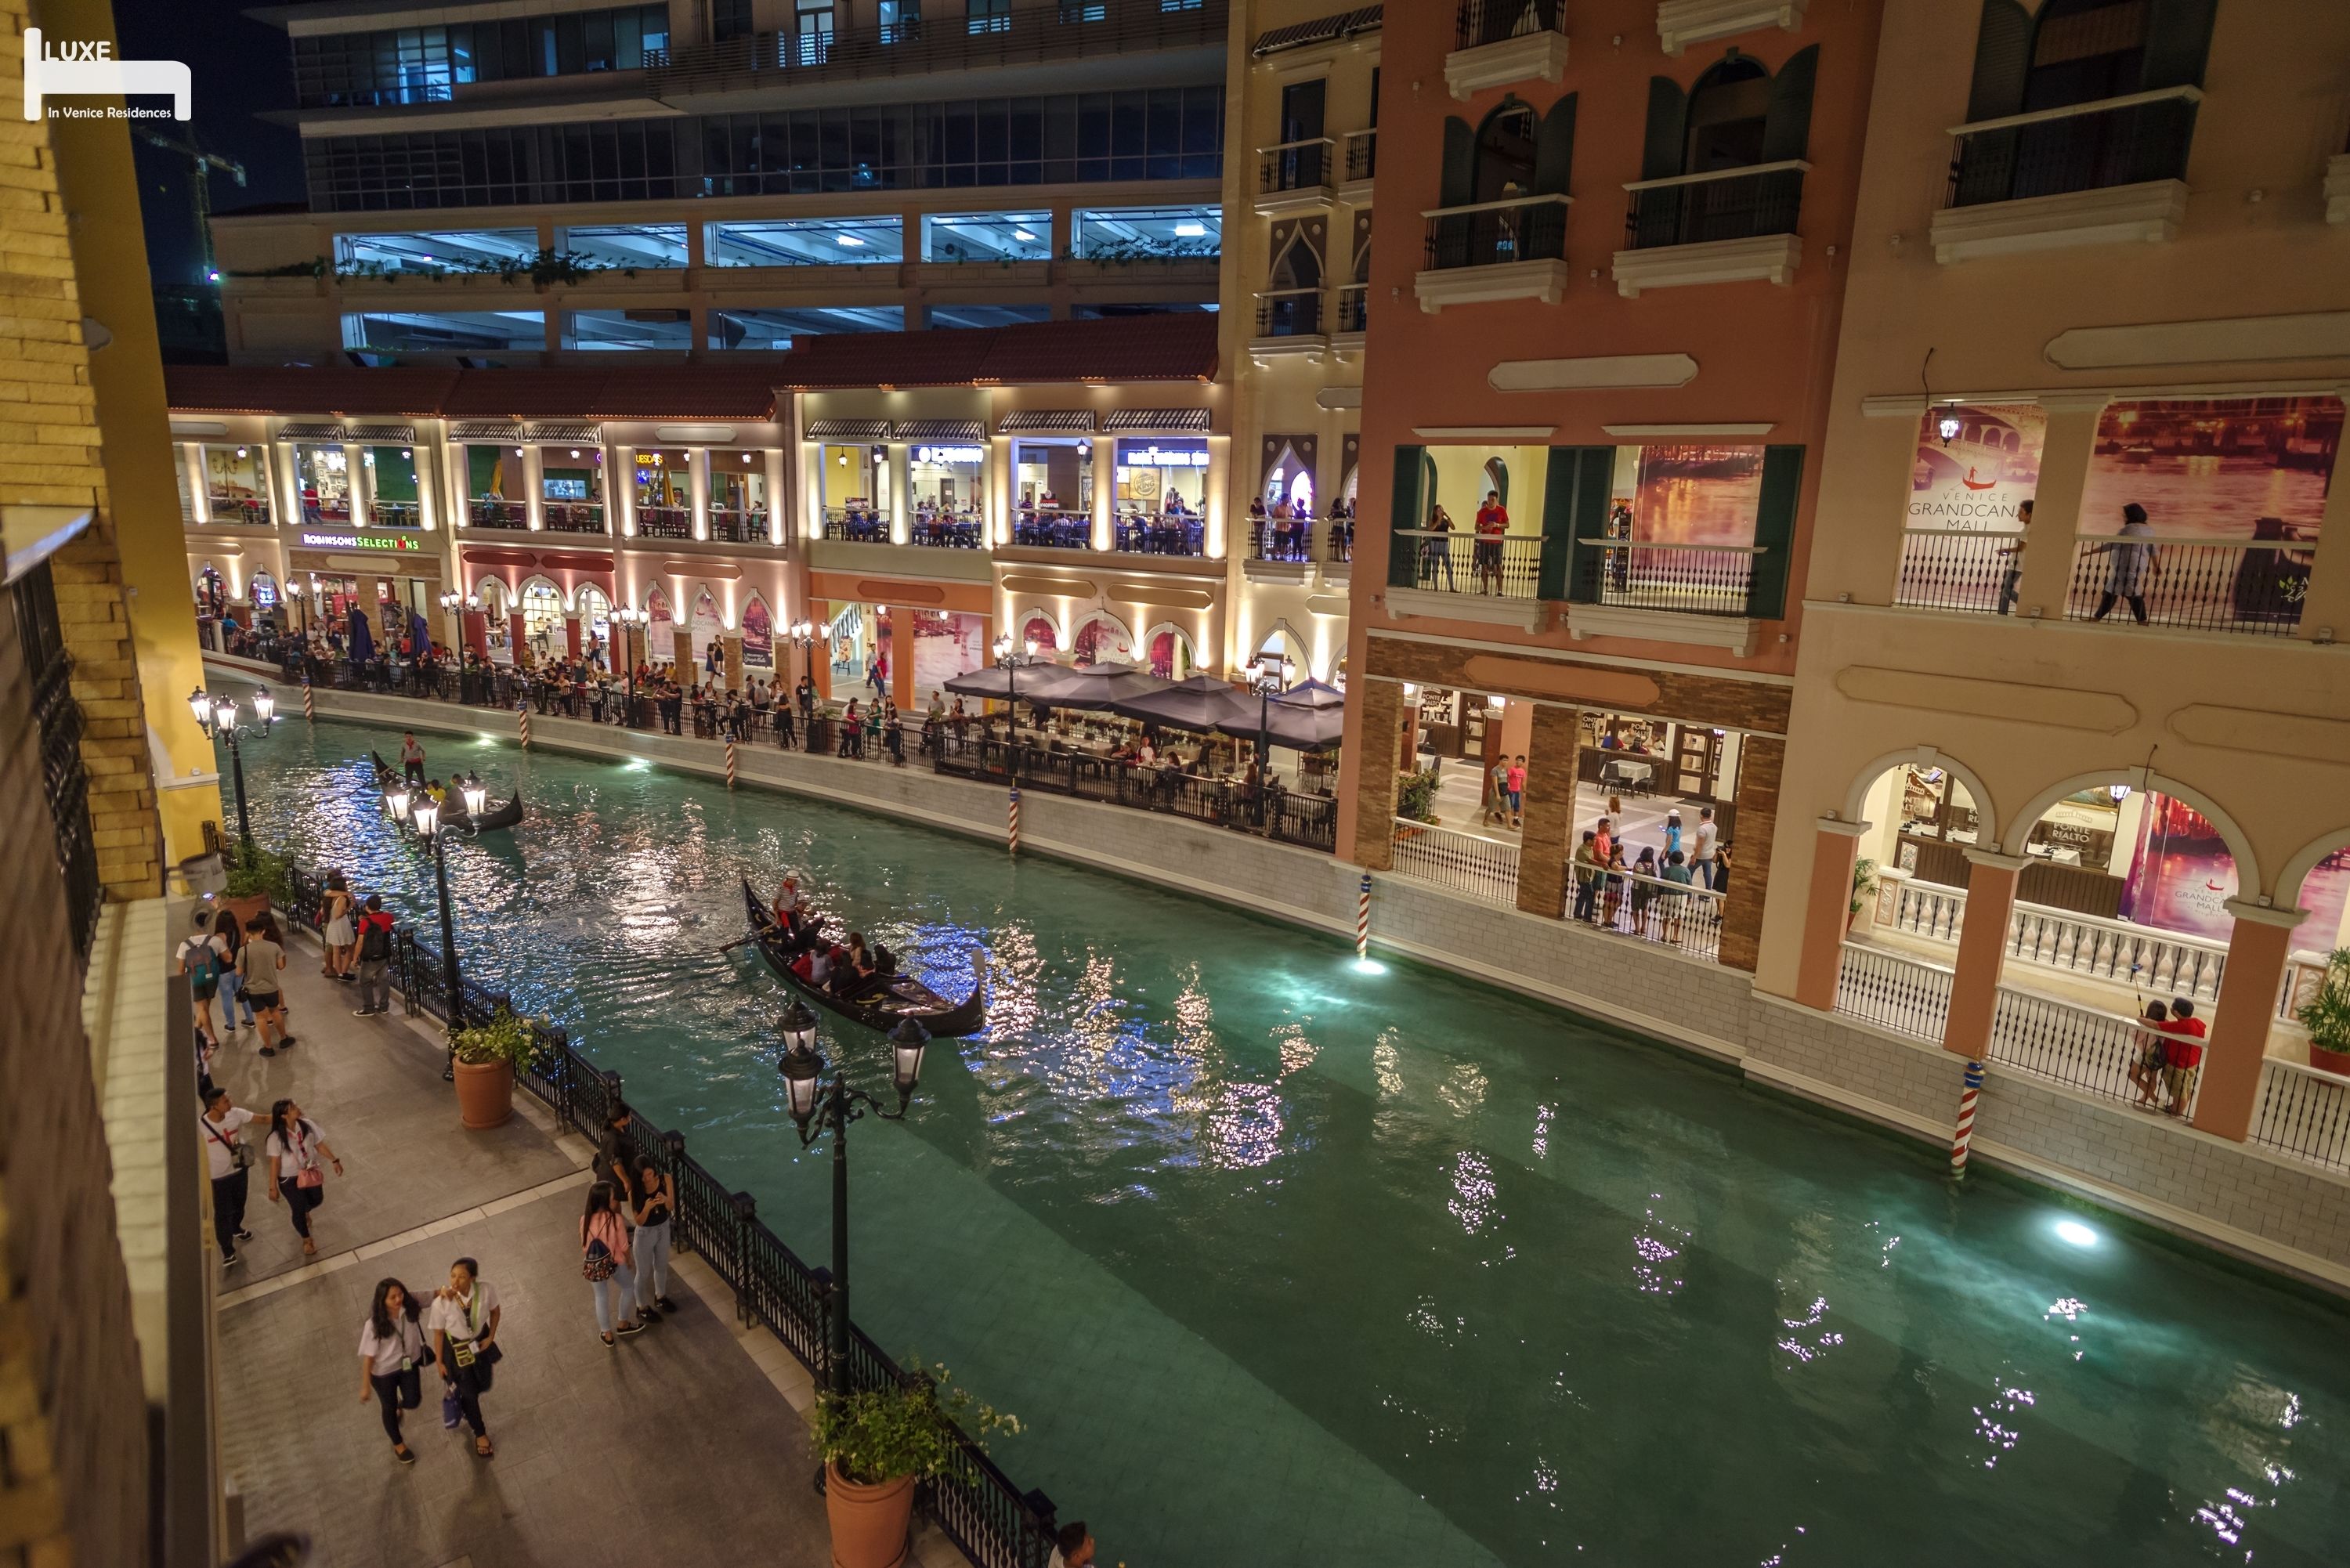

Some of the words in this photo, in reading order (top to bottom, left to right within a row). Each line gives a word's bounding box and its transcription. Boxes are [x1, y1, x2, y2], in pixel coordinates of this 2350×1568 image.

[1137, 480, 1155, 491] KING
[1943, 493, 2008, 501] VENICE
[1908, 502, 2019, 518] GRANDCAN
[2053, 822, 2091, 835] PONTE
[2052, 829, 2090, 843] RIALTO
[2175, 891, 2225, 904] GRANDCA
[2196, 901, 2222, 912] MALL
